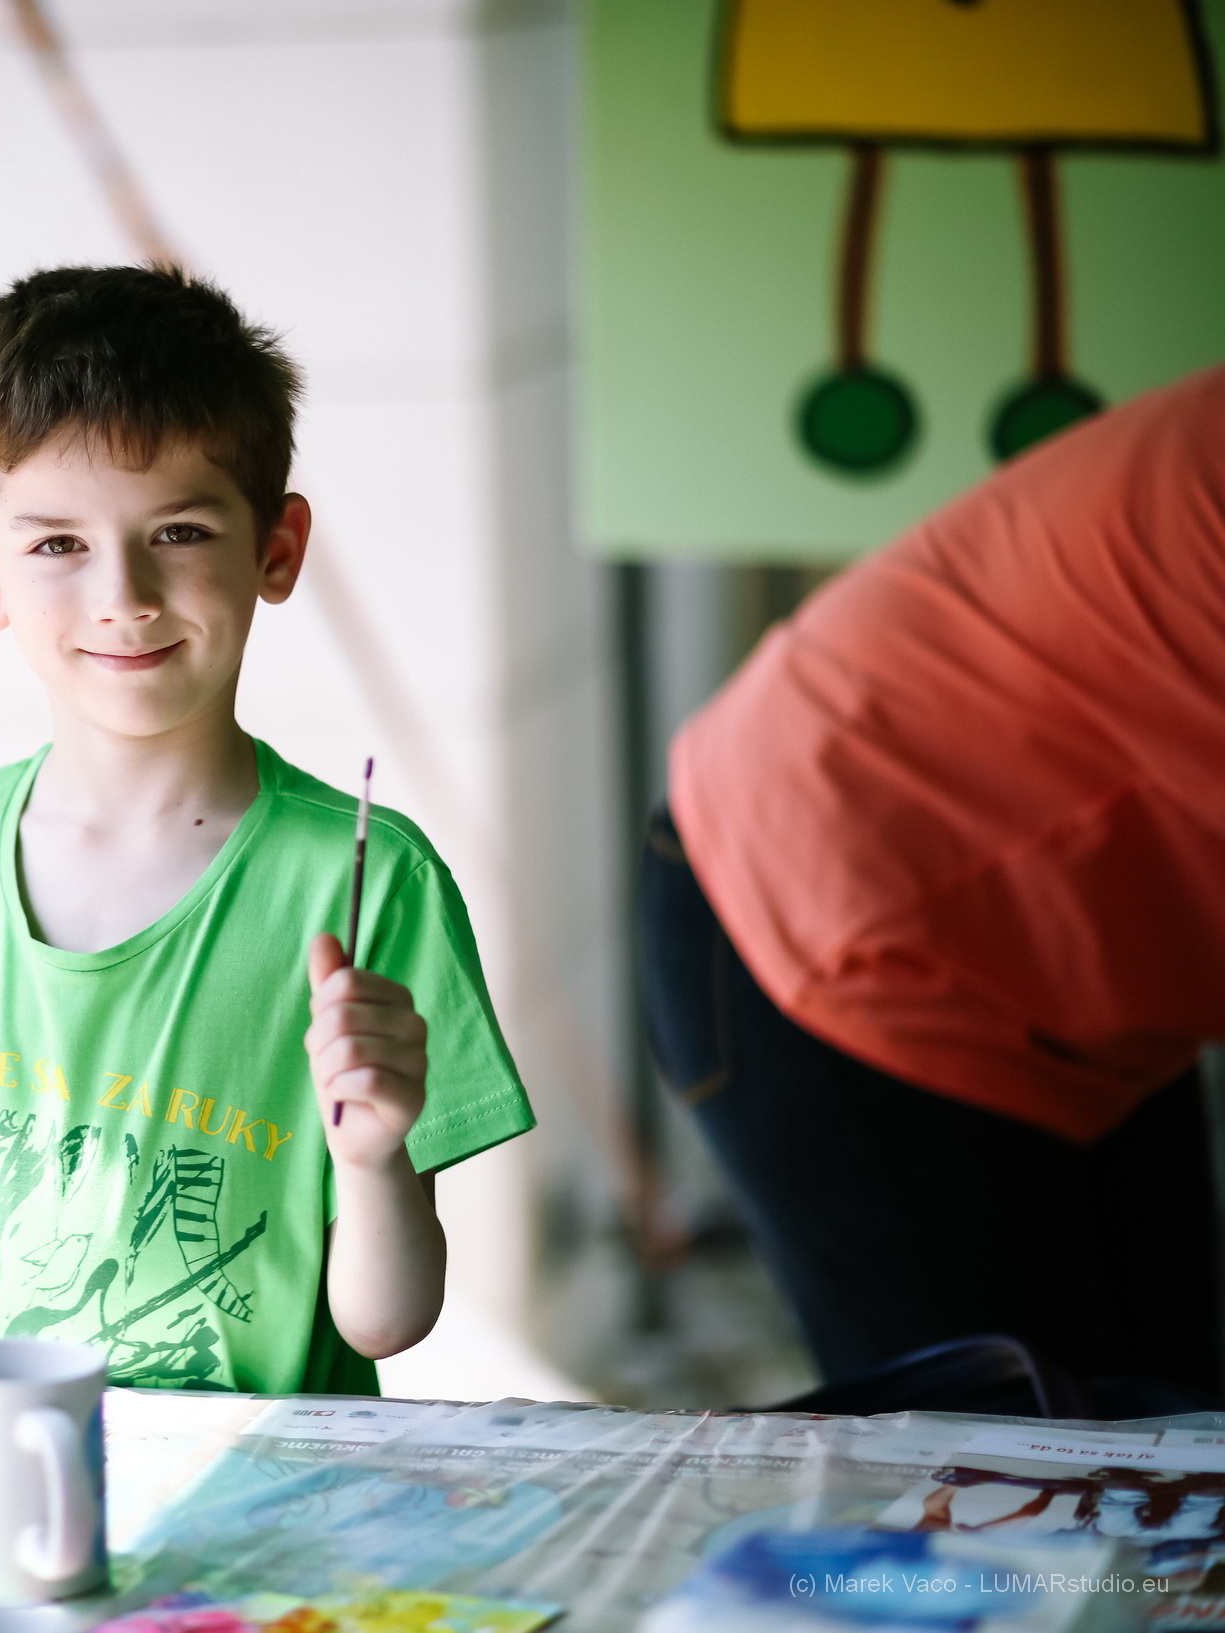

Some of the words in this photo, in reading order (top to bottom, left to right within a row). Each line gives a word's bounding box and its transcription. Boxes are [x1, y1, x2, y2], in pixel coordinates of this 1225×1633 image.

[31, 1058, 71, 1101] SA
[96, 1071, 153, 1118] ZA
[164, 1087, 294, 1161] RUKY
[1103, 1451, 1133, 1460] tak
[1137, 1453, 1155, 1461] aj
